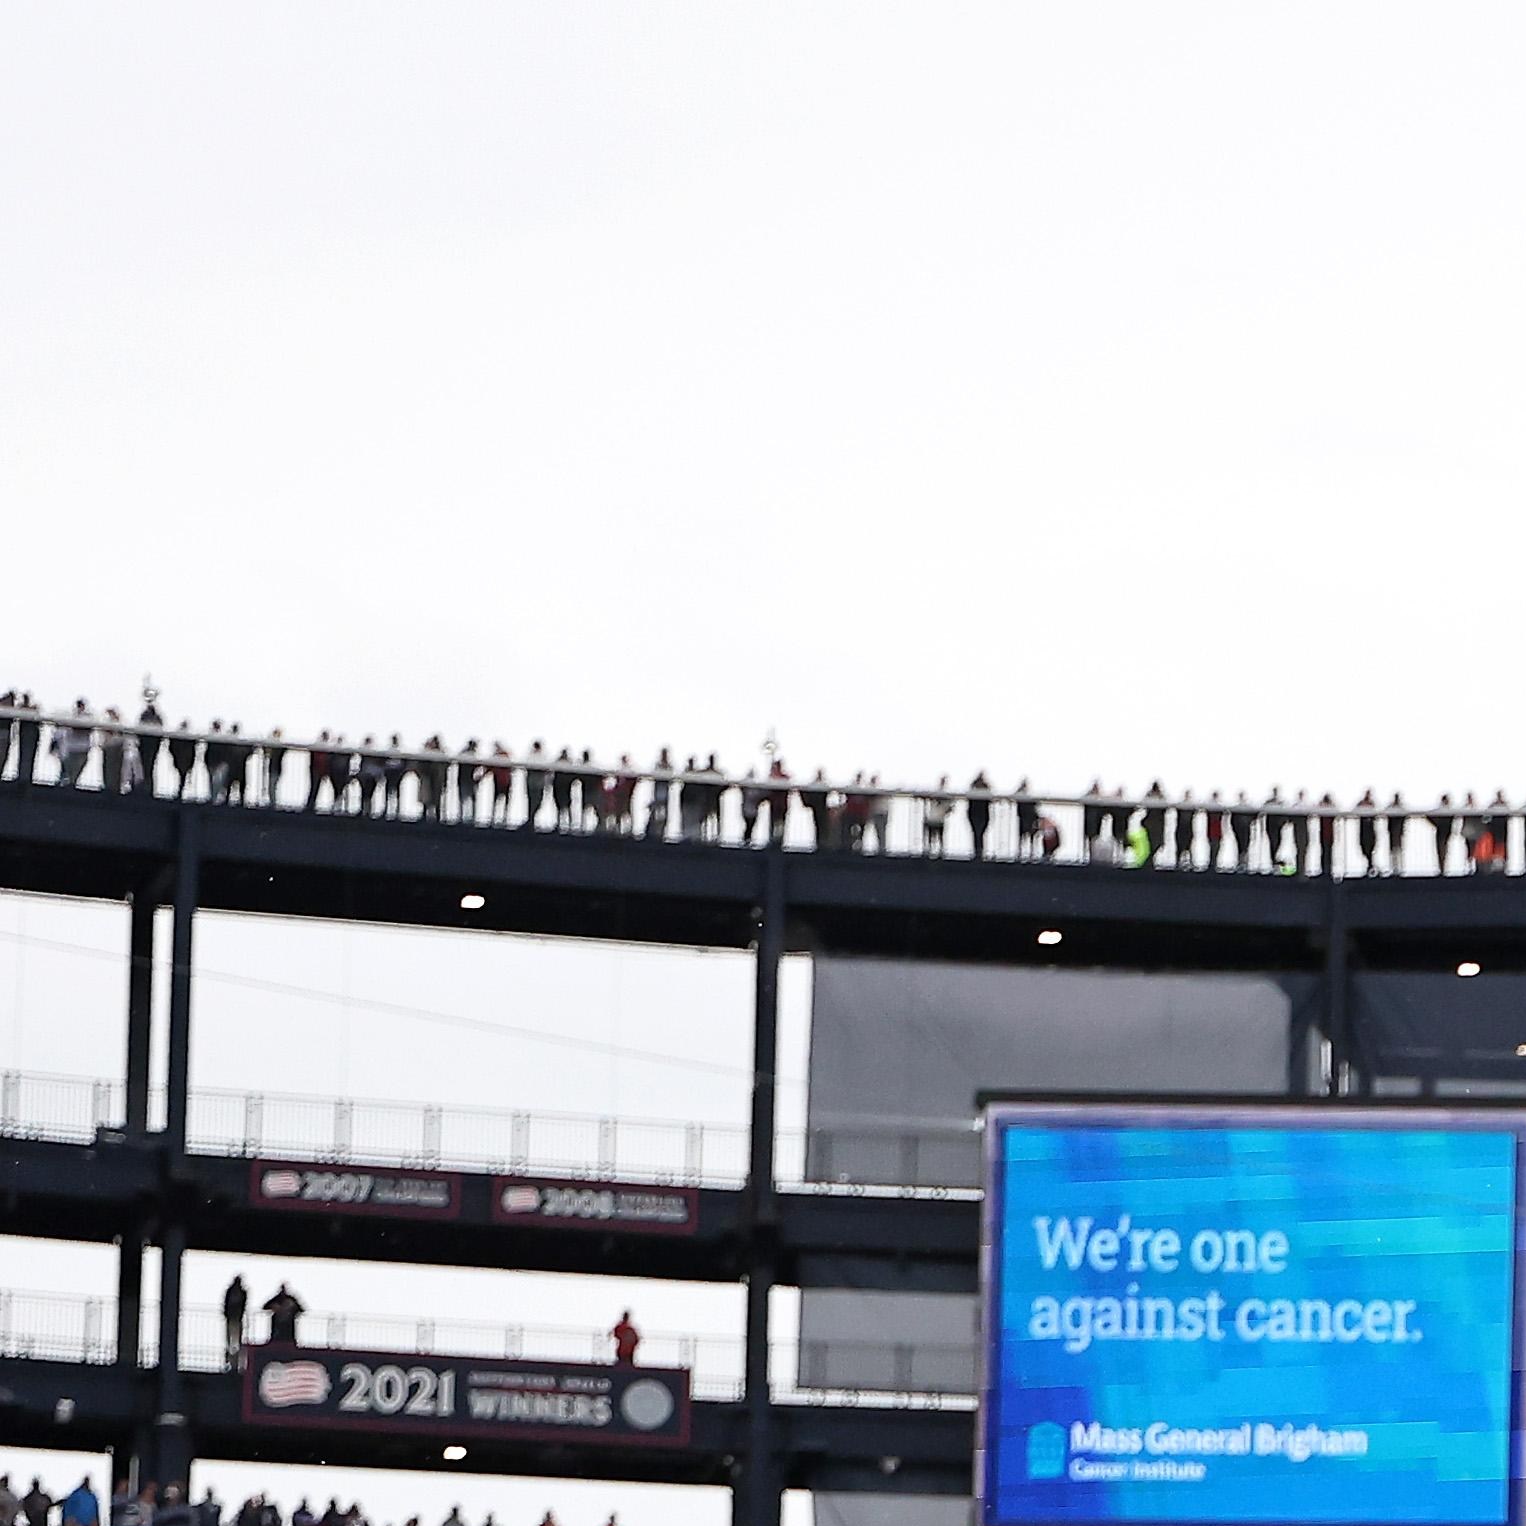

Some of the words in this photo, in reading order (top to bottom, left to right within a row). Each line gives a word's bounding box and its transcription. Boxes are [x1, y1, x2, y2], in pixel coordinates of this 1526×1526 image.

[1032, 1215, 1179, 1273] We're
[1191, 1227, 1290, 1274] one
[1028, 1283, 1225, 1354] against
[1236, 1297, 1423, 1343] cancer.
[339, 1362, 456, 1417] 2021
[1069, 1421, 1142, 1454] Mass
[1145, 1422, 1250, 1455] General
[1253, 1422, 1368, 1463] Brigham
